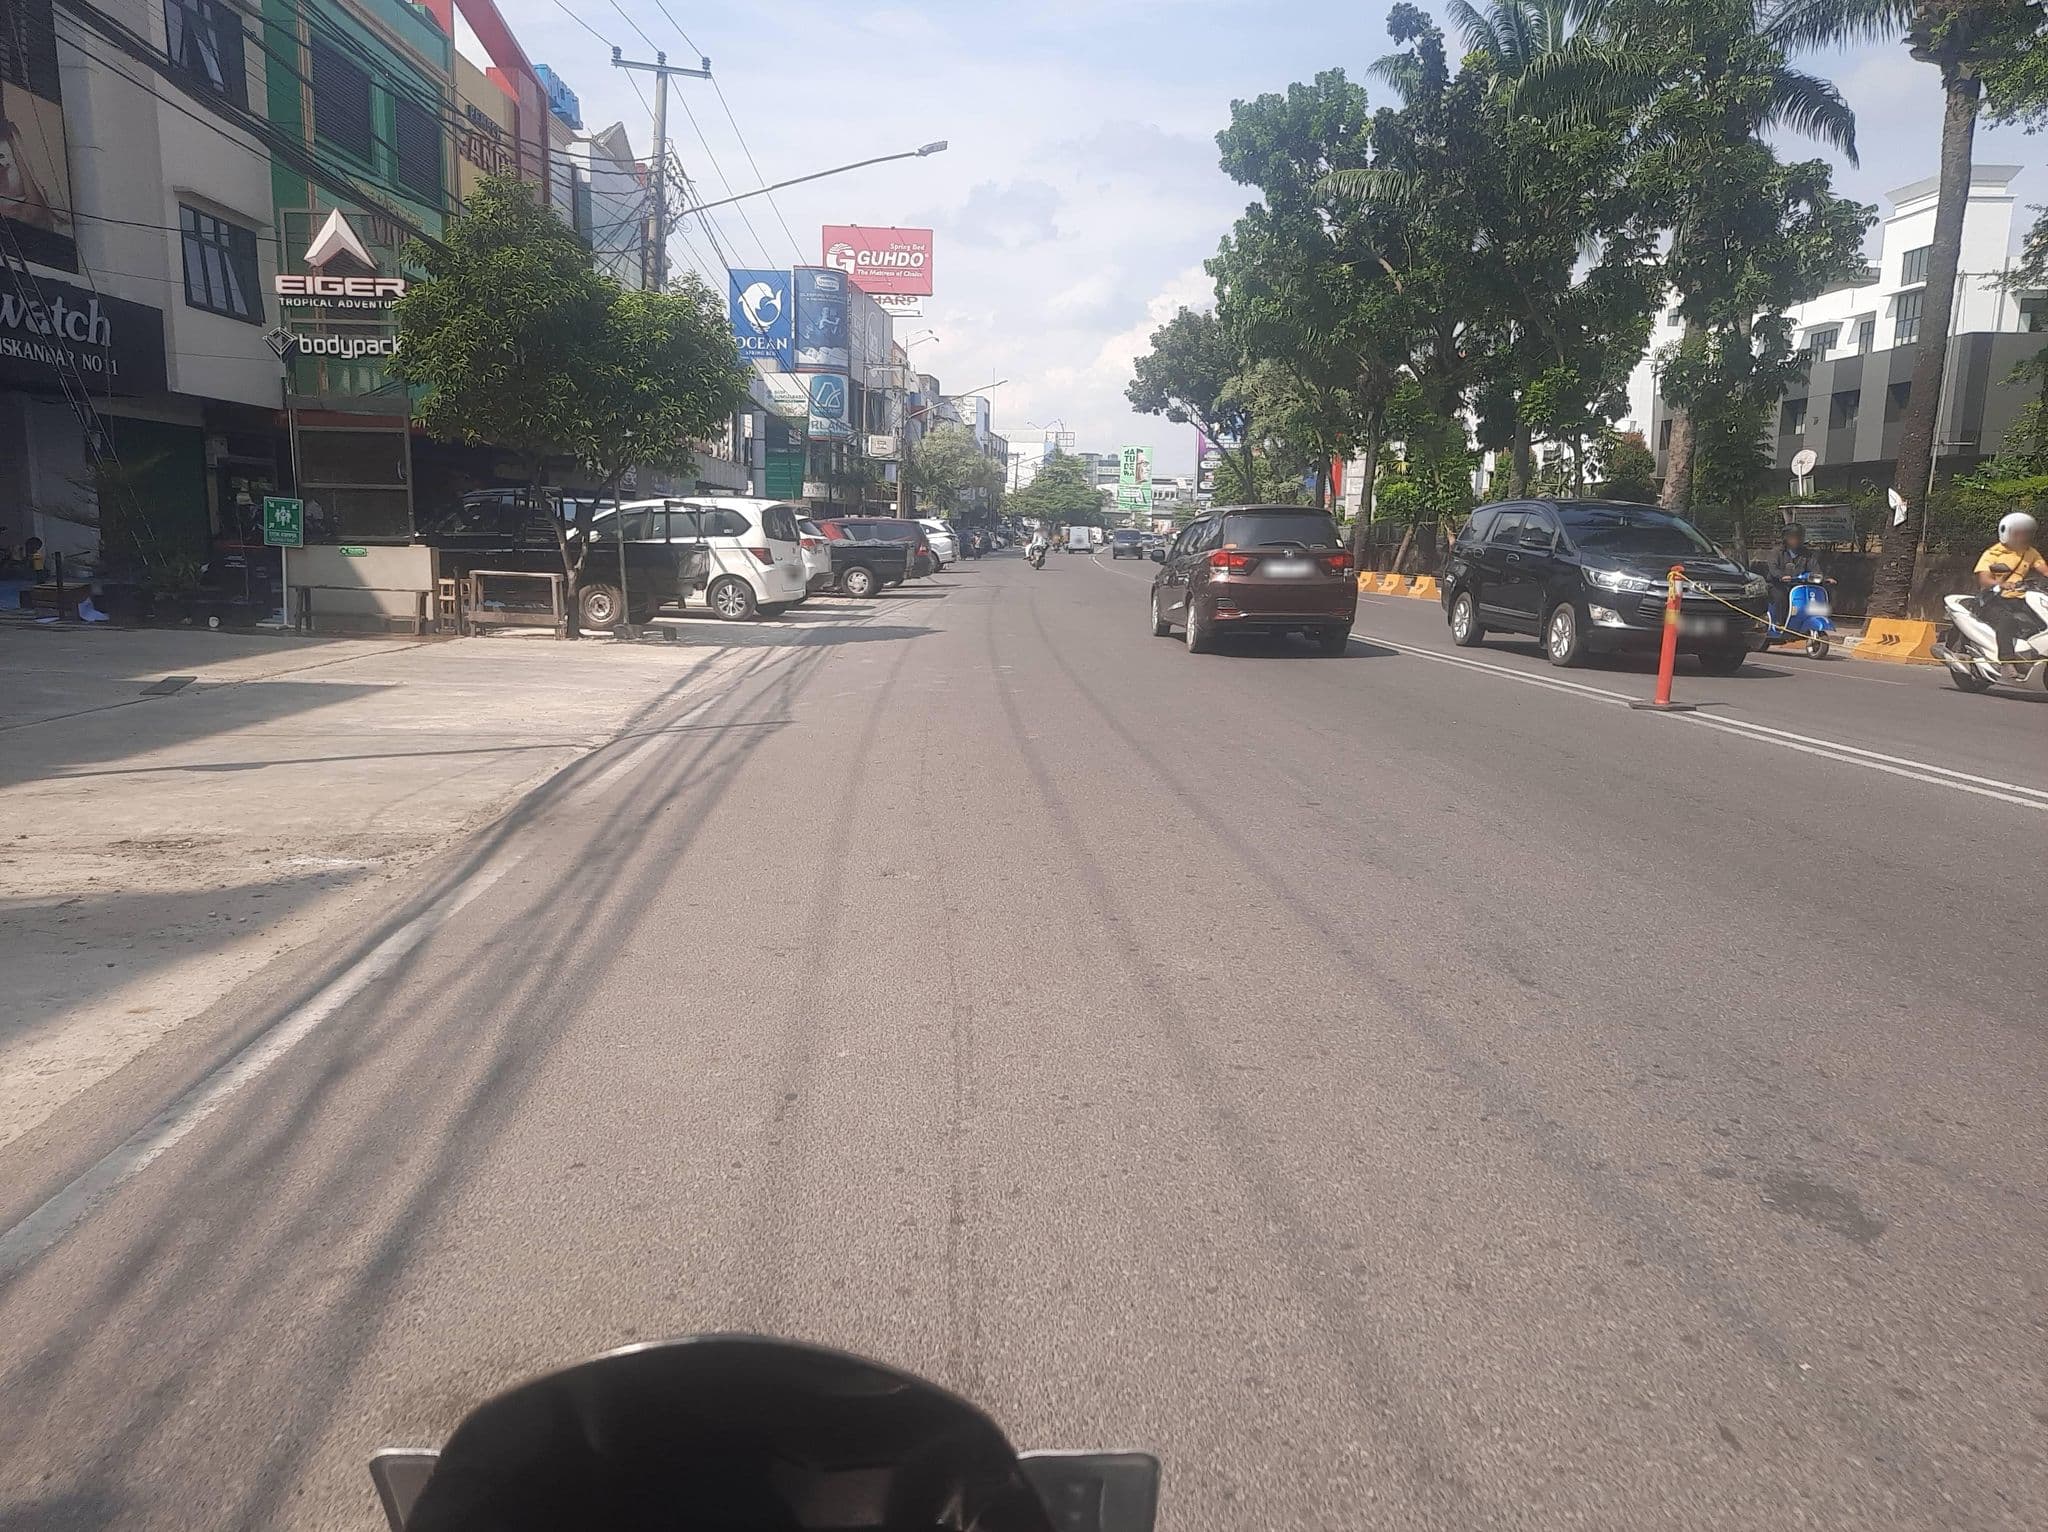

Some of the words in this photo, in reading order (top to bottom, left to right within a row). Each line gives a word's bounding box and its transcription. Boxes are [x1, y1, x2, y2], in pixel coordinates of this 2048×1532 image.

[890, 243, 911, 252] Spring
[912, 243, 925, 251] Bed
[857, 250, 925, 267] GUHDO
[275, 274, 407, 297] EIGER
[279, 298, 334, 308] TROPICAL
[338, 300, 396, 310] ADVENTU
[299, 333, 401, 359] bodypack
[735, 336, 788, 350] OCEAN
